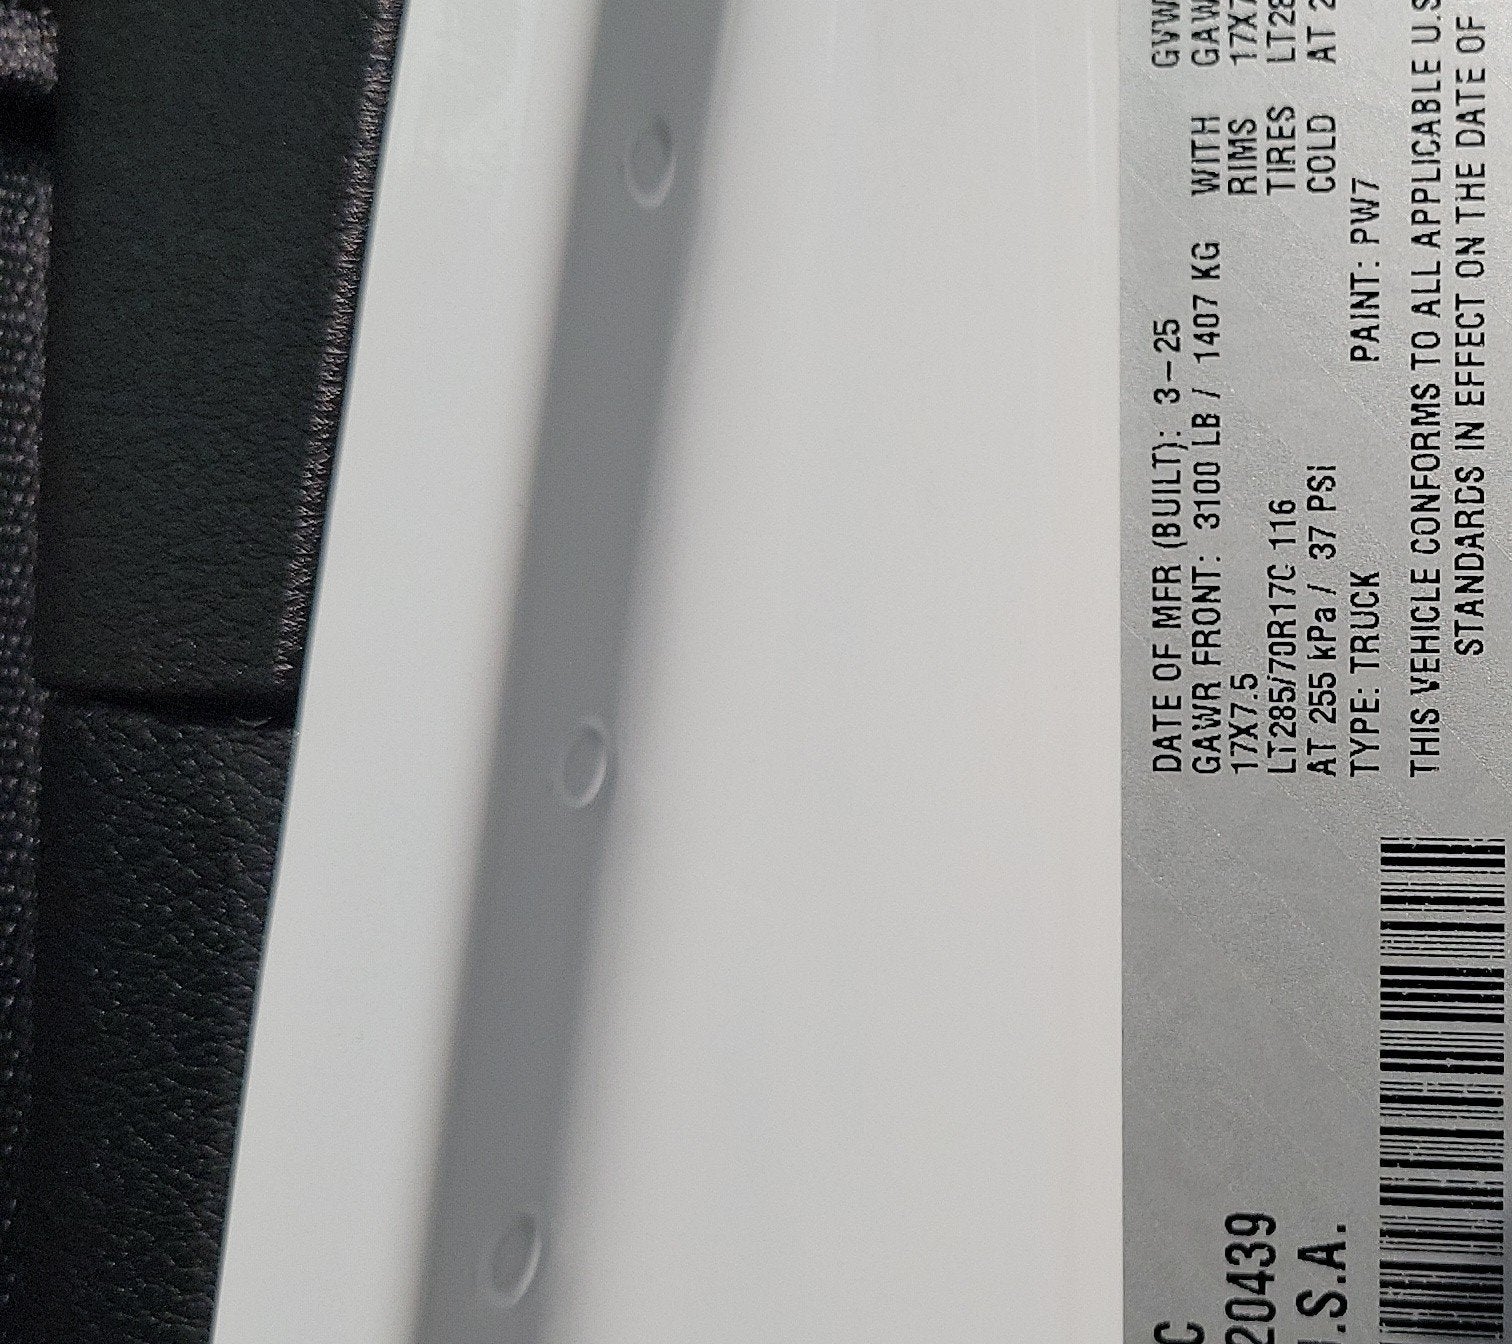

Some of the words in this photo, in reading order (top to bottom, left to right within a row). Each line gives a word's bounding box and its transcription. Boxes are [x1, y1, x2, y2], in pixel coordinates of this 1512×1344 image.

[1307, 26, 1335, 63] AT
[1456, 16, 1485, 53] OF
[1456, 68, 1485, 147] DATE
[1191, 117, 1220, 196] WITH
[1228, 119, 1257, 195] RIMS
[1266, 106, 1295, 196] TIRES
[1307, 115, 1336, 193] COLD
[1411, 60, 1441, 248] APPLICABLE
[1350, 178, 1379, 244] PW7
[1455, 163, 1485, 224] THE
[1191, 243, 1220, 279] KG
[1411, 261, 1440, 318] ALL
[1455, 237, 1485, 278] ON
[1193, 295, 1220, 363] 1407
[1350, 262, 1379, 361] PAINT:
[1411, 331, 1440, 370] TO
[1455, 293, 1485, 406] EFFECT
[1192, 388, 1220, 399] /
[1192, 414, 1220, 445] LB
[1455, 423, 1484, 450] IN
[1152, 432, 1188, 548] (BUILT):
[1193, 462, 1220, 529] 3100
[1307, 466, 1336, 511] PSI
[1411, 383, 1440, 554] CONFORMS
[1269, 500, 1296, 550] 116
[1309, 526, 1336, 559] 37
[1307, 584, 1336, 595] /
[1454, 467, 1484, 655] STANDARDS
[1152, 565, 1181, 628] MFR
[1192, 557, 1221, 665] FRONT:
[1350, 572, 1379, 674] TRUCK
[1152, 644, 1181, 681] OF
[1307, 608, 1336, 659] kPa
[1410, 569, 1440, 695] VEHICLE
[1267, 565, 1296, 773] LT285/70R17C
[1308, 673, 1336, 724] 255
[1153, 696, 1181, 772] DATE
[1192, 682, 1221, 773] GAWR
[1228, 674, 1258, 774] 17X7.5
[1307, 738, 1336, 777] AT
[1350, 689, 1379, 777] TYPE:
[1410, 709, 1439, 777] THIS
